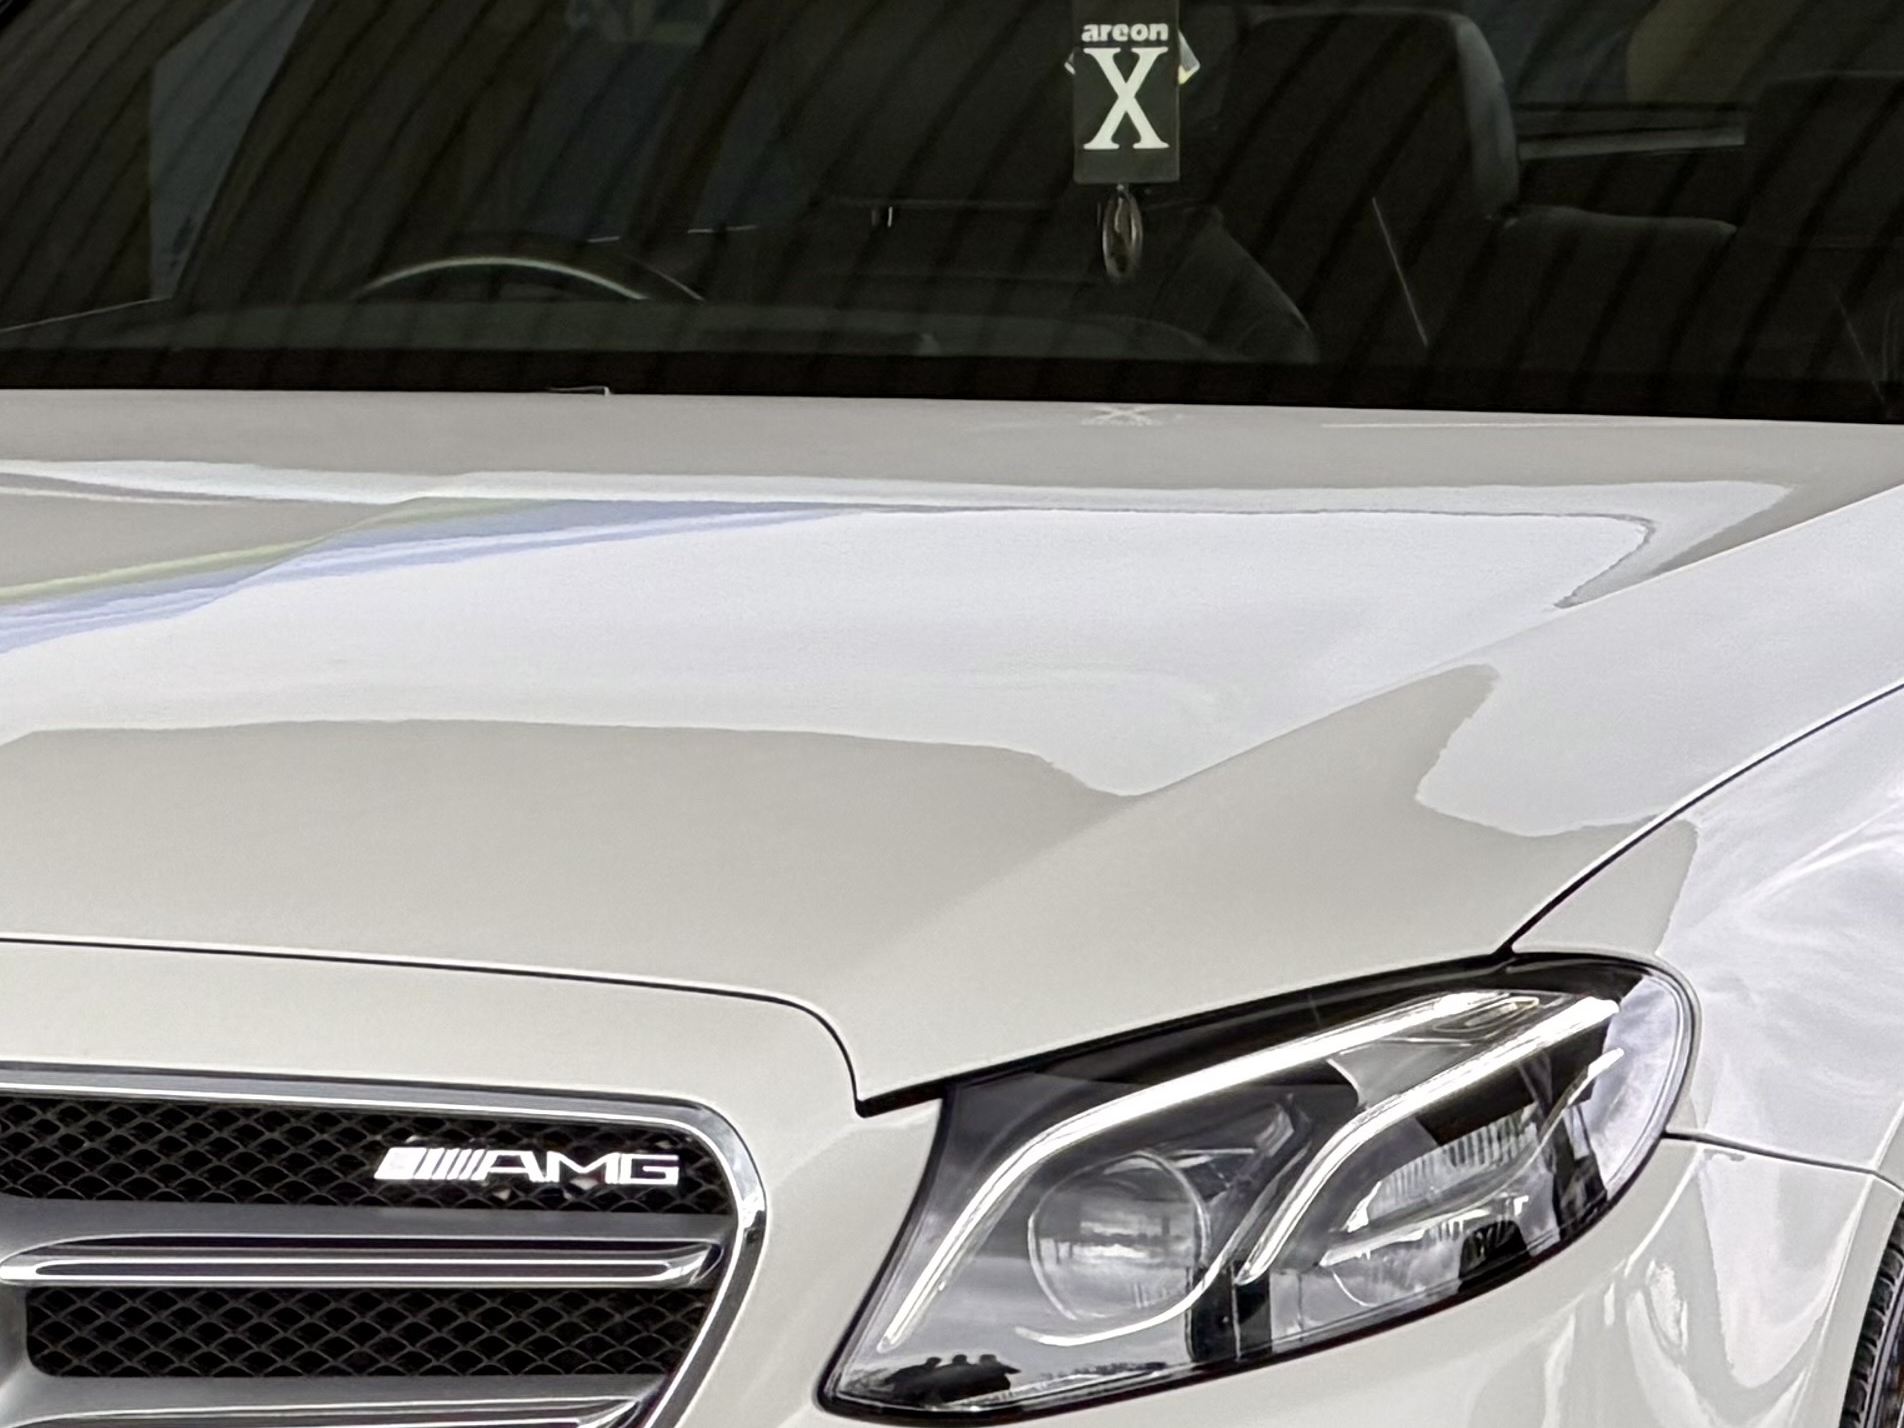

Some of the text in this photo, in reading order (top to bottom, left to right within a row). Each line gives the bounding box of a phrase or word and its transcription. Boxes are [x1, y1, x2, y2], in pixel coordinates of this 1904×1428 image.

[1081, 22, 1169, 43] areon
[1082, 46, 1170, 150] X
[472, 1148, 680, 1186] AMG
